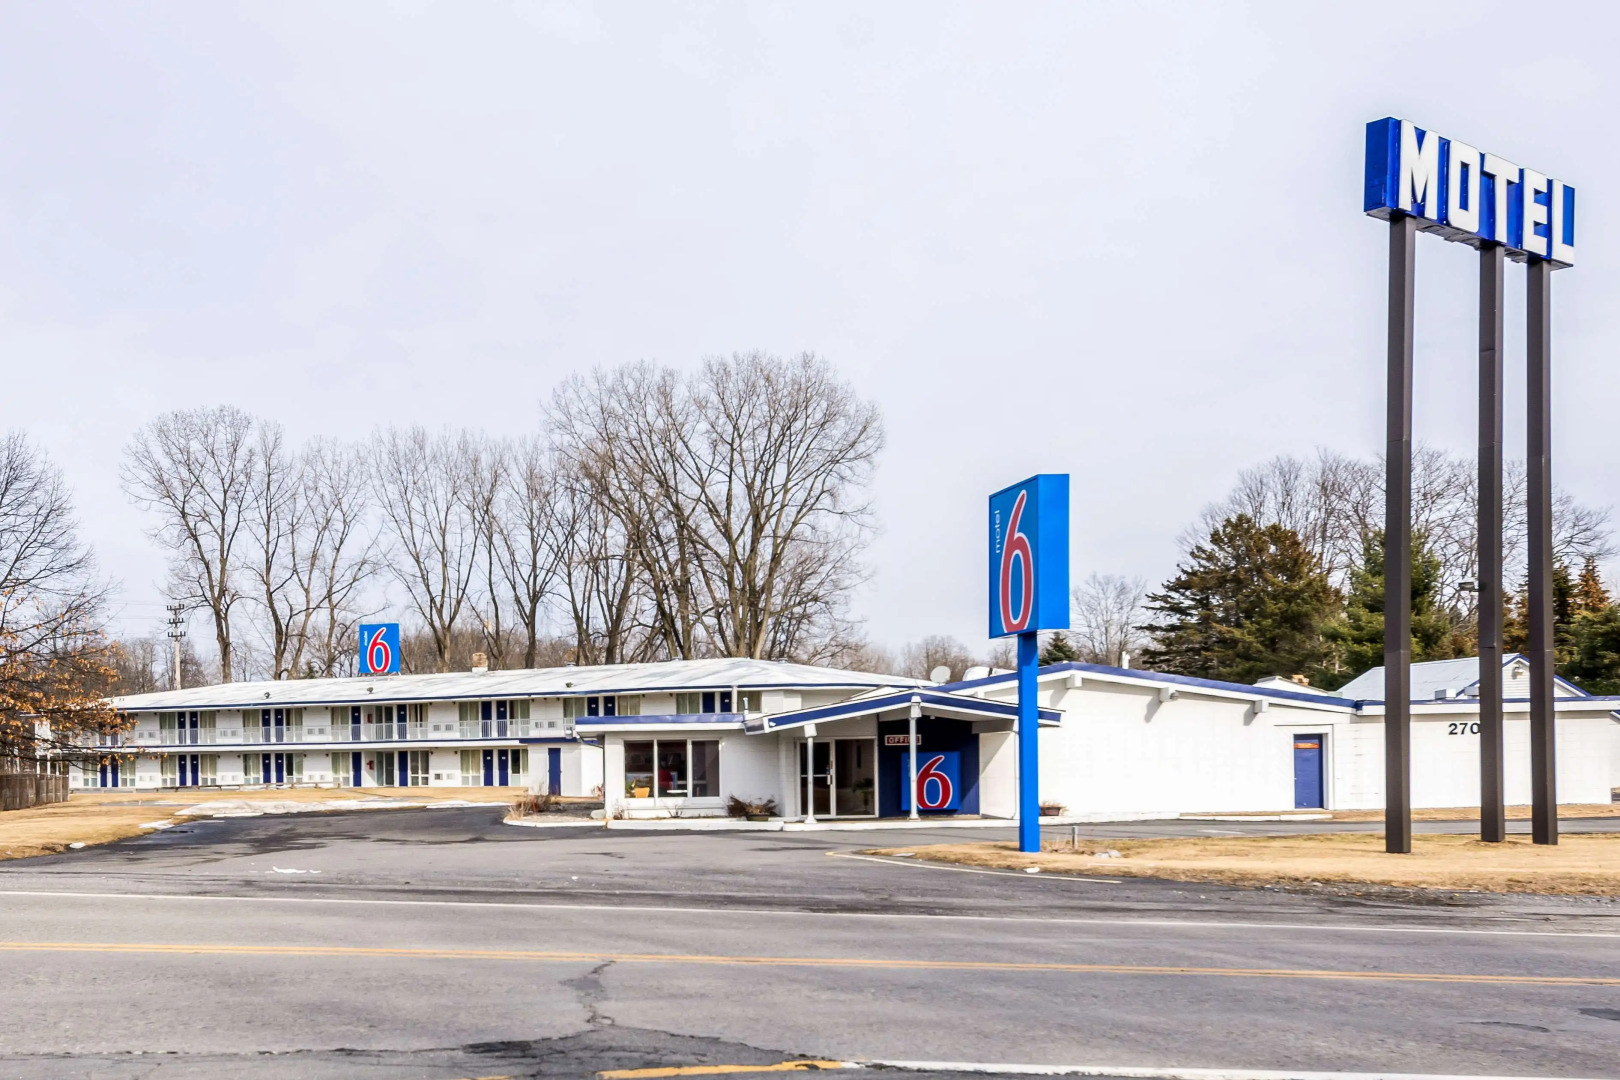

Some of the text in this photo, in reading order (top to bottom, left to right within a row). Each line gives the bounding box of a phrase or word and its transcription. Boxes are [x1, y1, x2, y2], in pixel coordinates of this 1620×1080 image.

[1398, 119, 1575, 267] MOTEL
[999, 489, 1034, 633] 6
[367, 627, 391, 673] 6
[916, 755, 953, 809] 6
